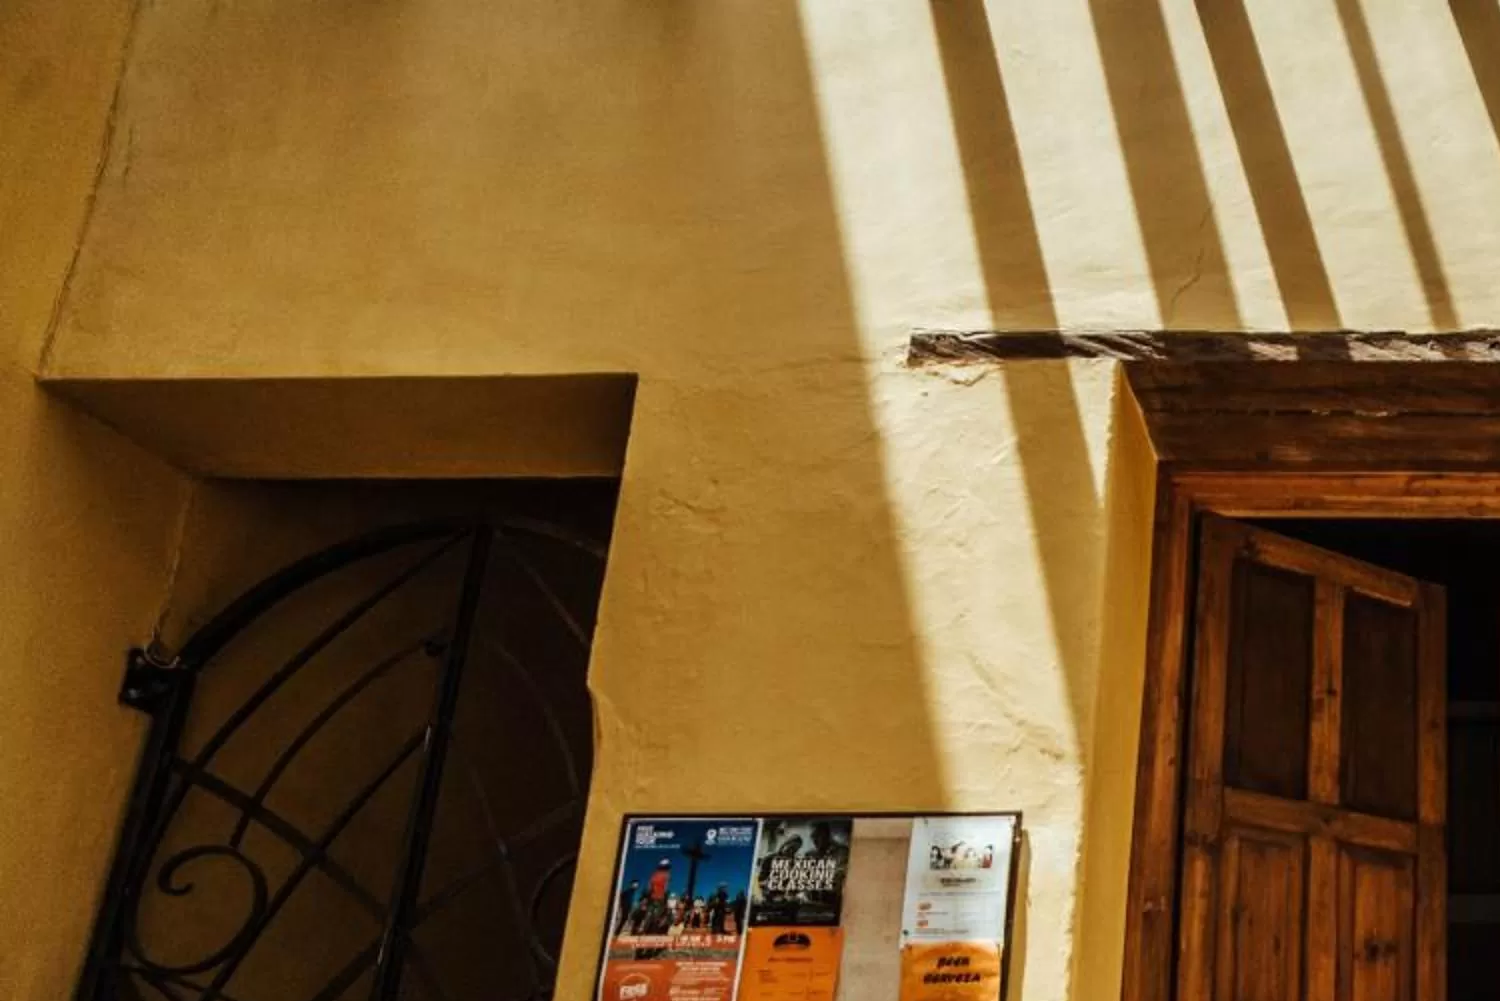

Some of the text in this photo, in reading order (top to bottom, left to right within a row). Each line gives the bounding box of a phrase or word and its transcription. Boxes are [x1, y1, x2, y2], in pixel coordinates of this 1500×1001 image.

[771, 859, 837, 869] MEXICAN
[769, 869, 835, 880] COOKING
[767, 880, 834, 891] CLASSES
